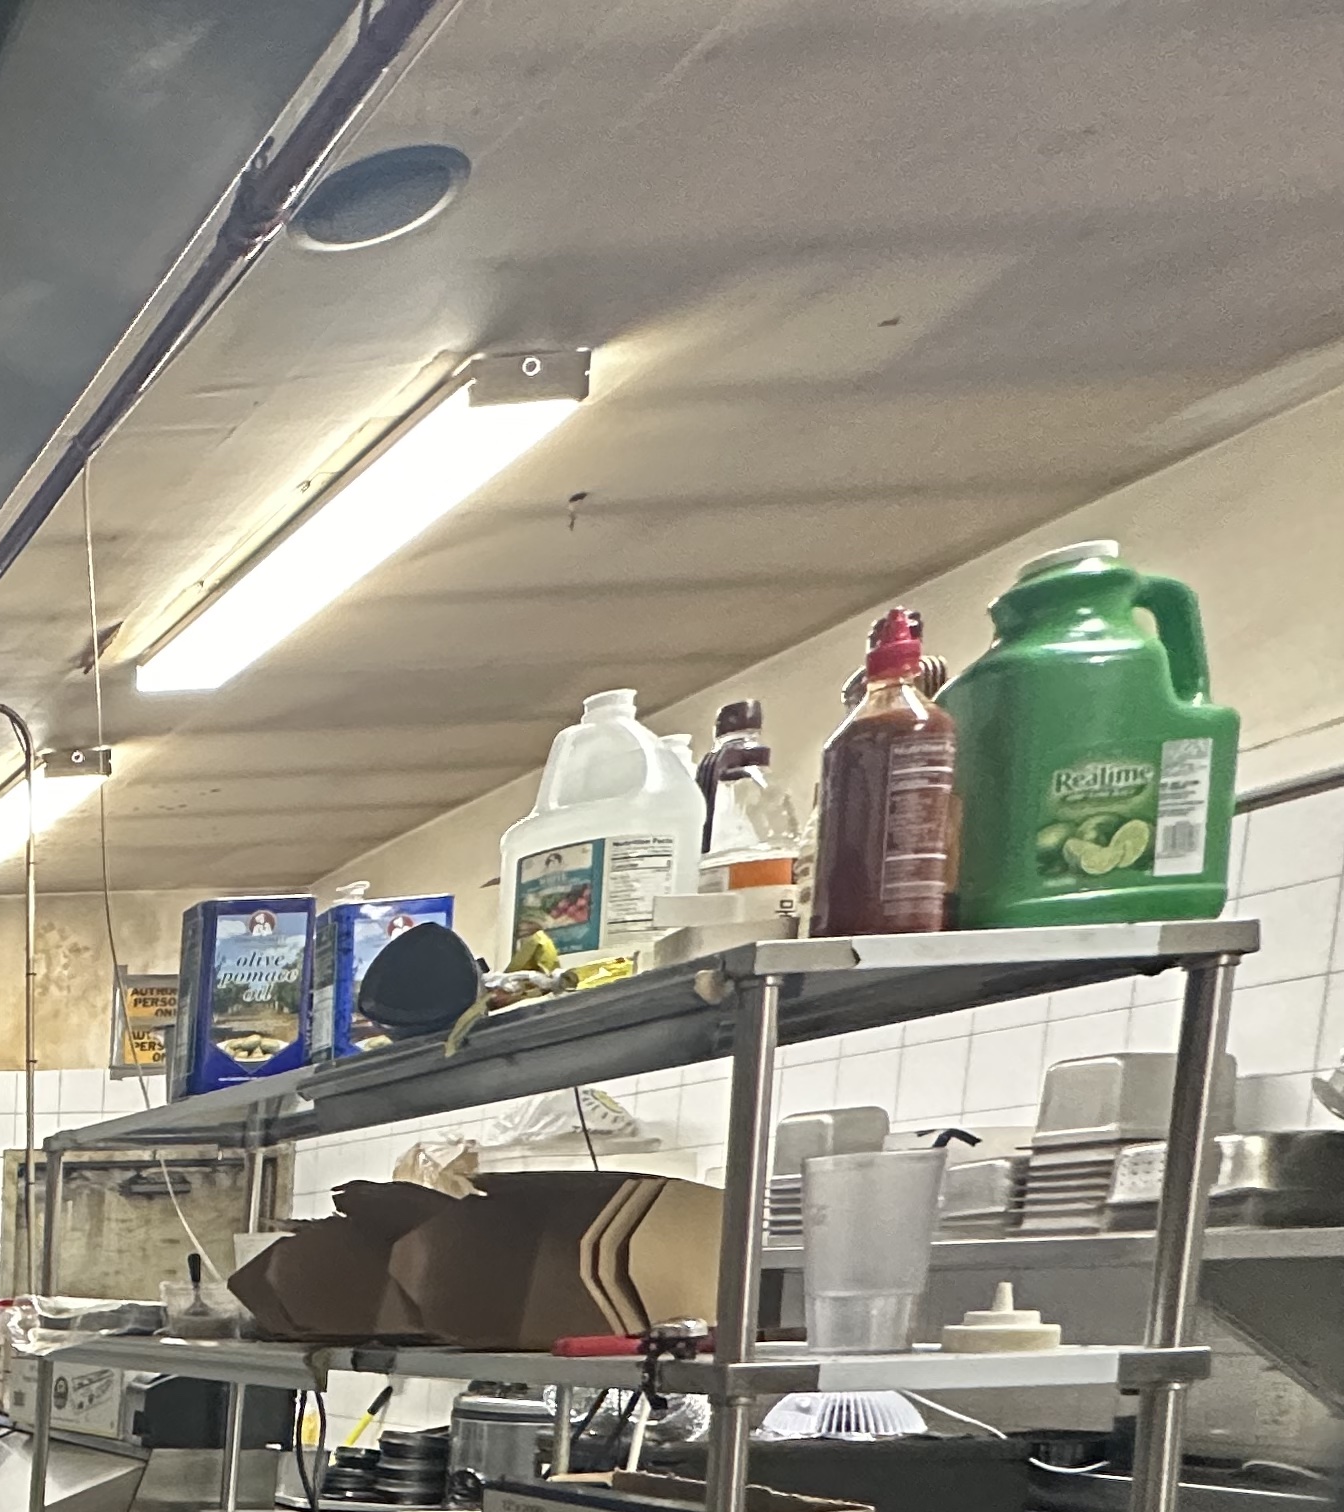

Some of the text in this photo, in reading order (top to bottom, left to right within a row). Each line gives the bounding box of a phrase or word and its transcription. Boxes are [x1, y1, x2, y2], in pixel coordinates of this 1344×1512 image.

[236, 951, 286, 968] olive
[217, 967, 300, 989] pomace
[242, 983, 275, 1003] oil
